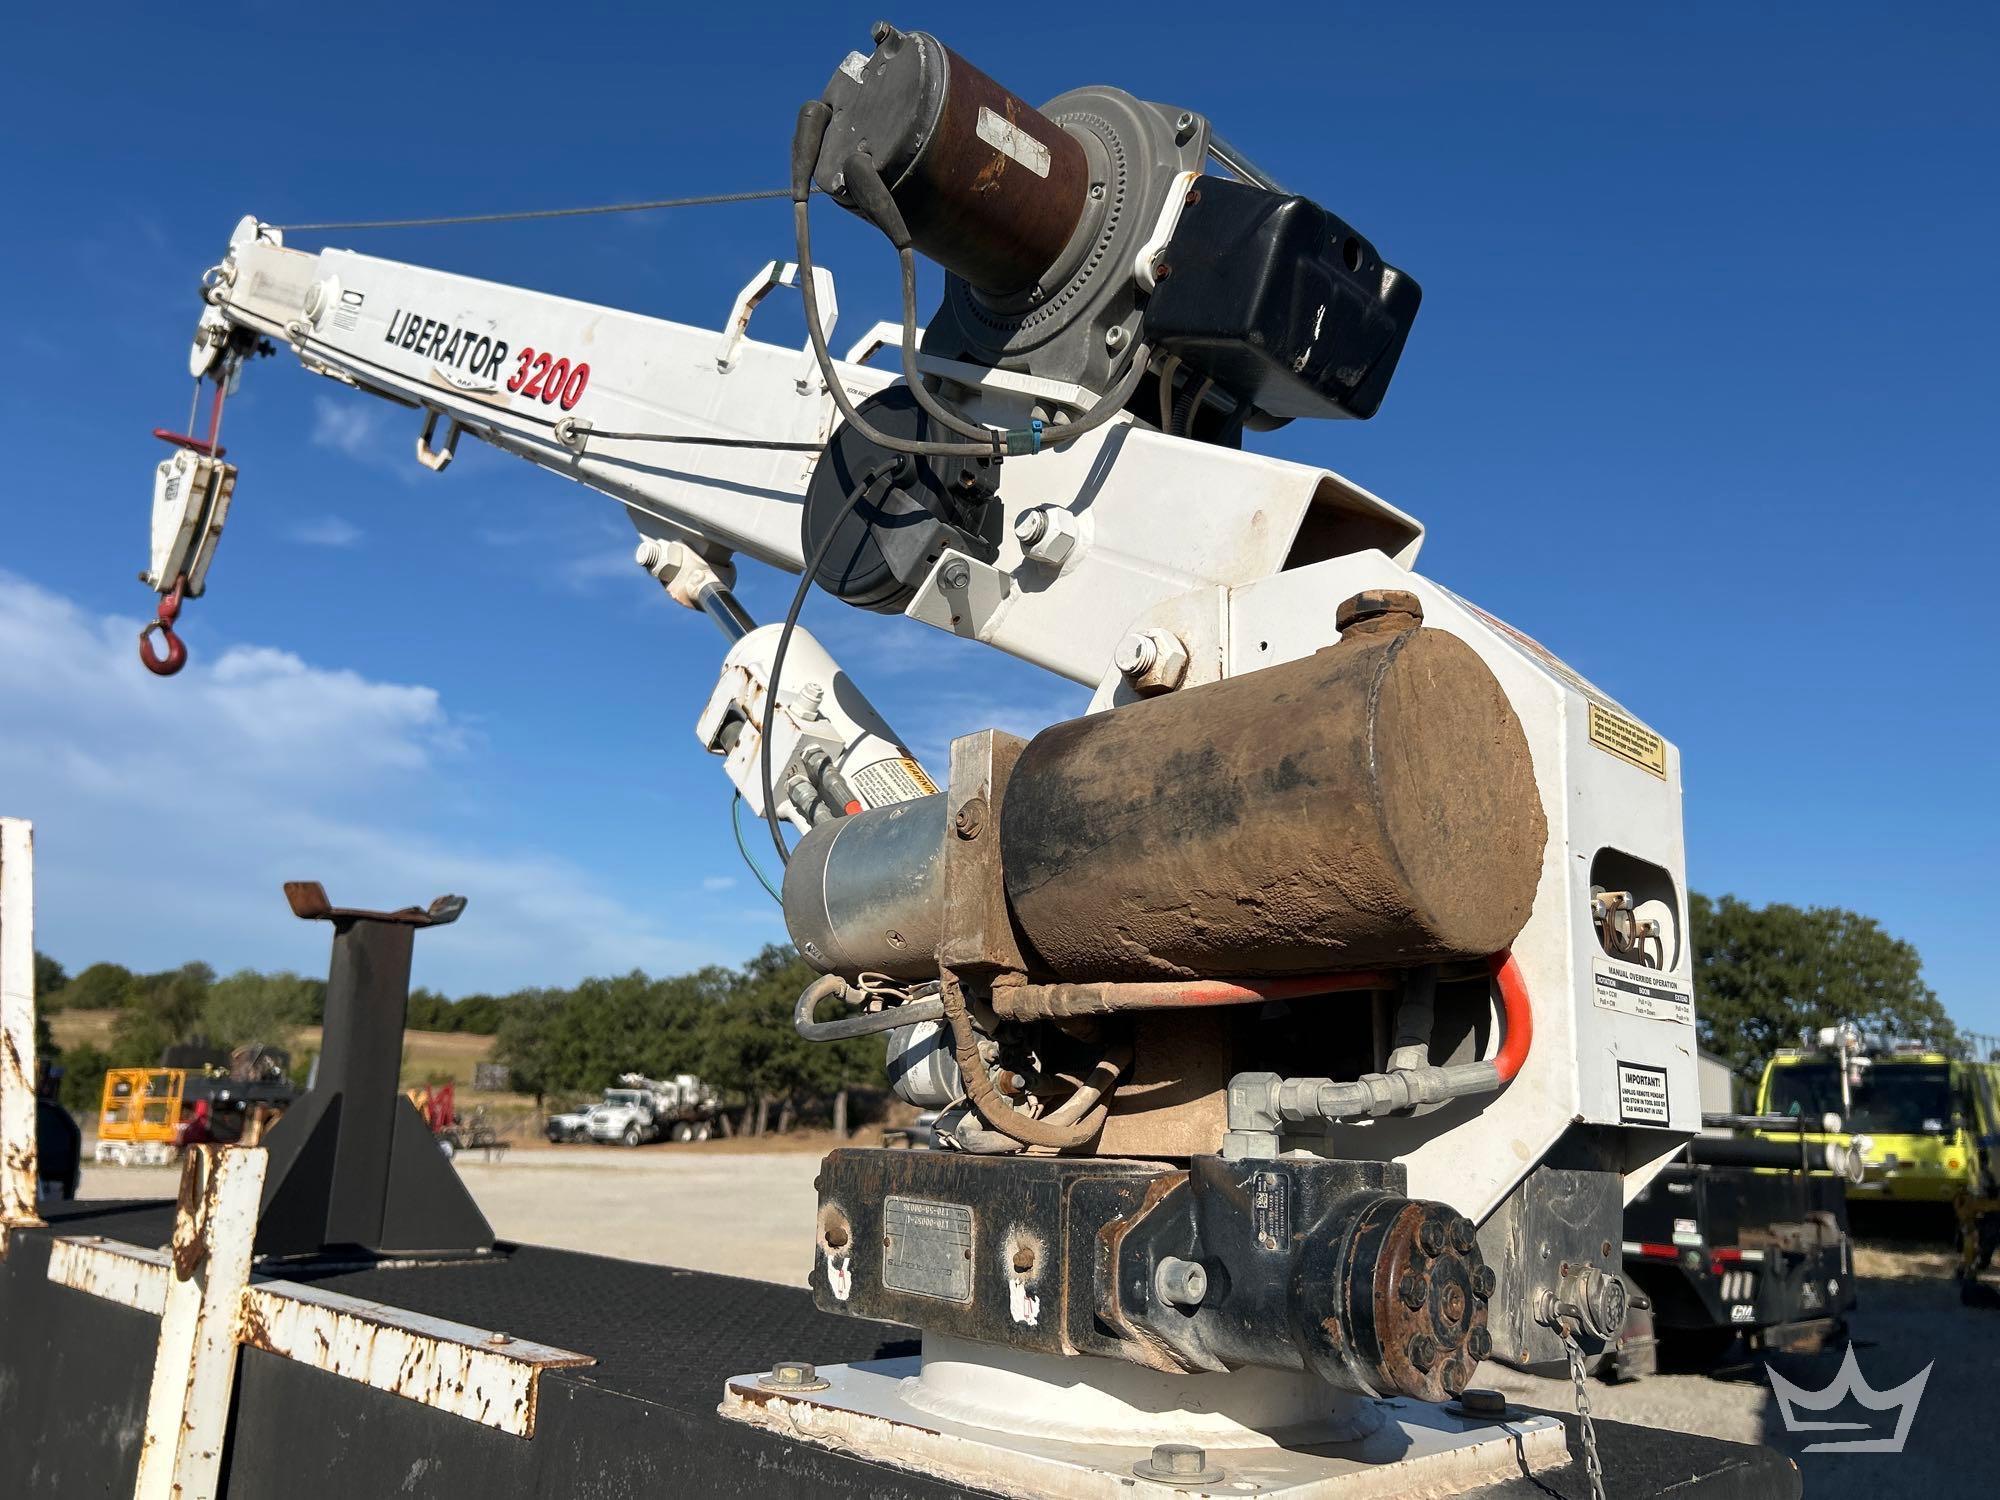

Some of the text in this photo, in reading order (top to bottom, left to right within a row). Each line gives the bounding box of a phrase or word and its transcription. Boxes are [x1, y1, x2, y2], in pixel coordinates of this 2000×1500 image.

[385, 309, 591, 411] LIBERATOR 3200
[904, 762, 936, 795] WARNIN
[1608, 966, 1678, 990] MANUAL OVERRIDE OPERATION
[1625, 1073, 1661, 1087] IMPORTANT!
